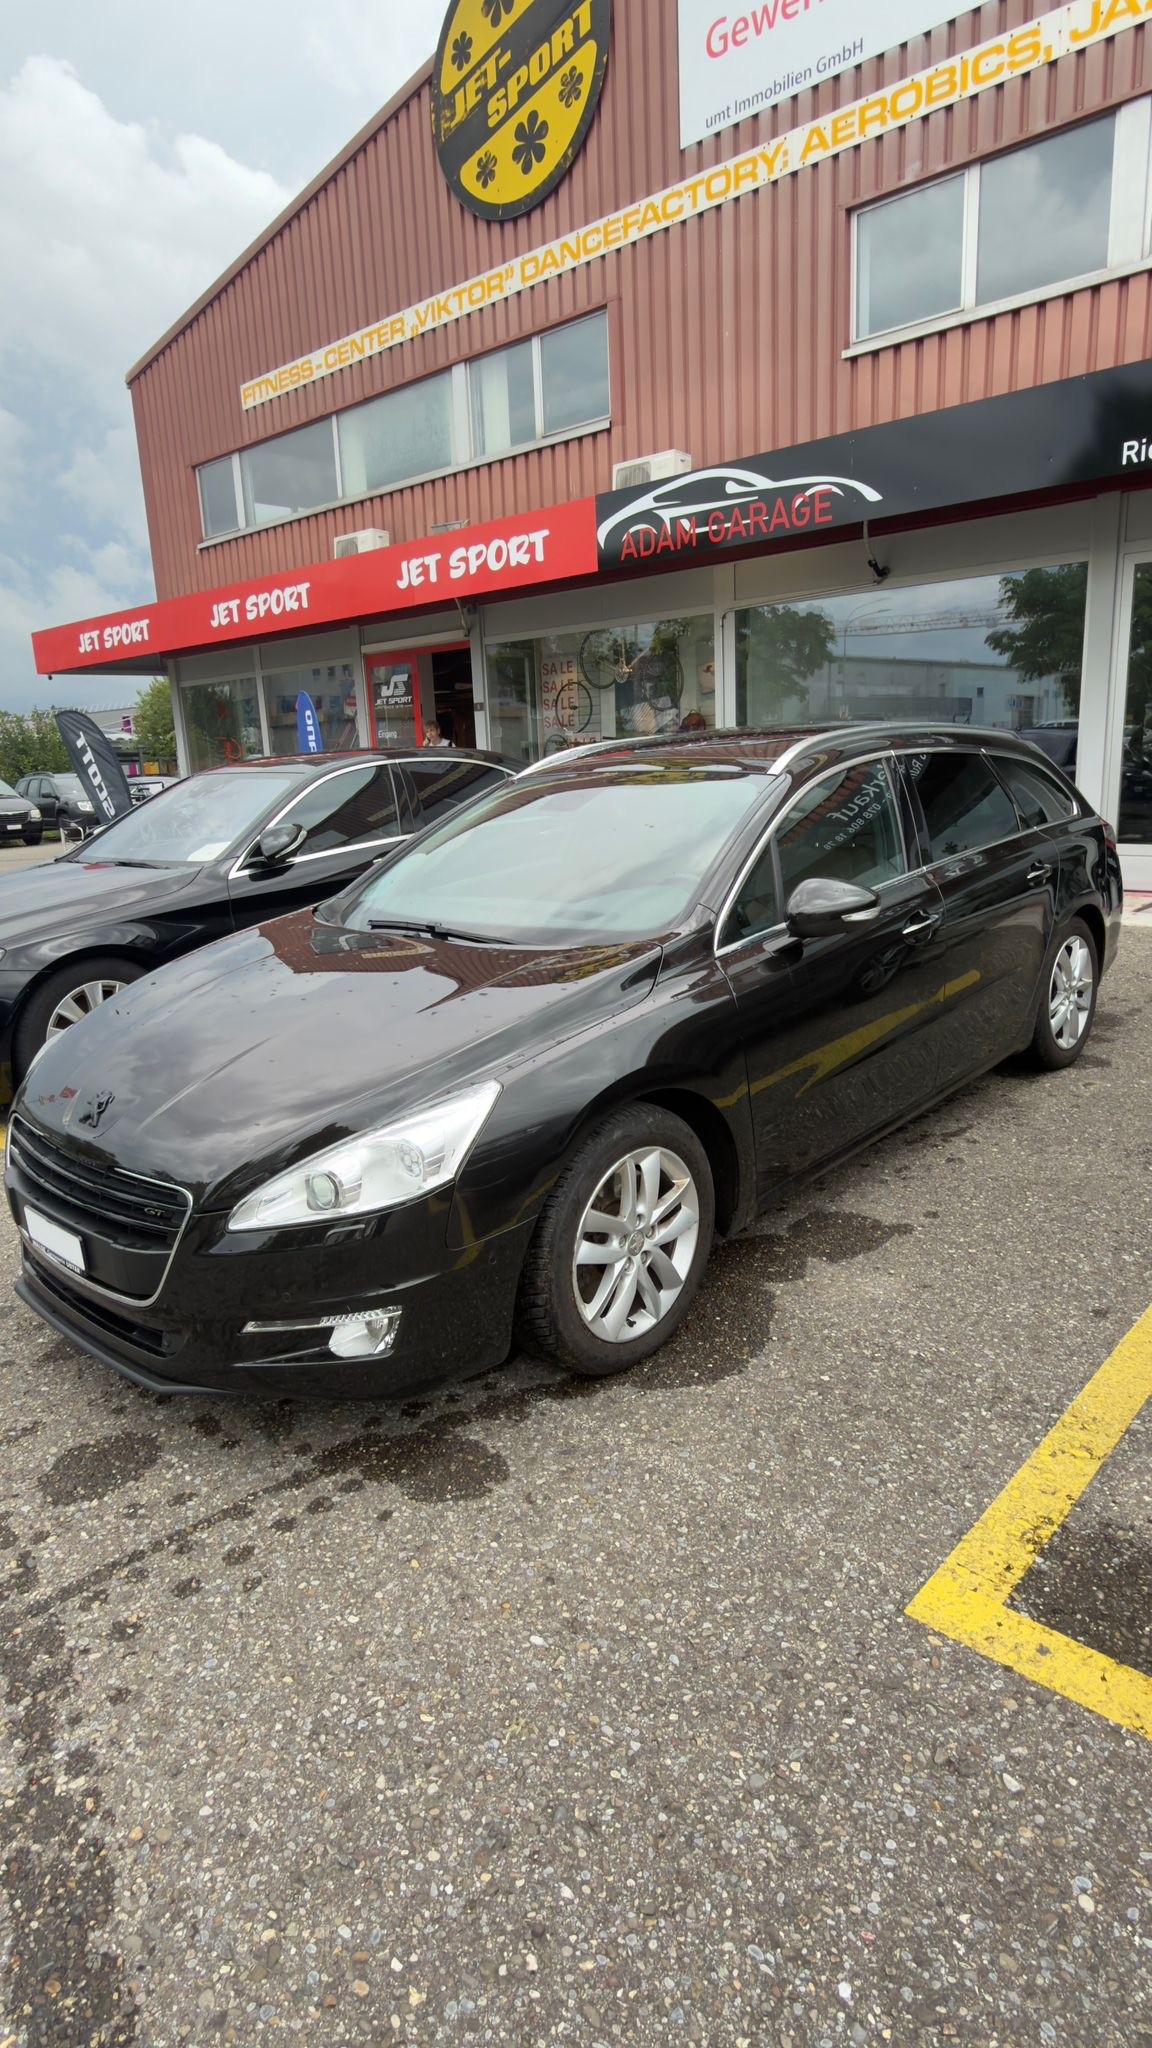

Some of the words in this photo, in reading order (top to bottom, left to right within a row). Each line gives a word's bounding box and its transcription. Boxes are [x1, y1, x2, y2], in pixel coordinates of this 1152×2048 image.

[450, 48, 512, 128] JET-
[488, 0, 592, 128] SPORT
[705, 105, 731, 129] umt
[734, 67, 812, 115] Immobilien
[816, 37, 864, 74] GmbH
[520, 141, 789, 284] DANCEFACTORY:
[800, 26, 1052, 162] AEROBICS,
[621, 517, 698, 562] ADAM
[708, 487, 833, 544] GARAGE
[397, 551, 439, 590] JET
[449, 529, 550, 580] SPORT
[210, 597, 241, 628] JET
[245, 582, 310, 622] SPORT
[78, 629, 101, 654] JET
[104, 619, 150, 649] SPORT
[542, 660, 574, 676] SALE
[543, 679, 574, 694] SALE
[375, 697, 388, 706] JET
[389, 696, 412, 705] SPORT
[143, 1206, 165, 1217] GT
